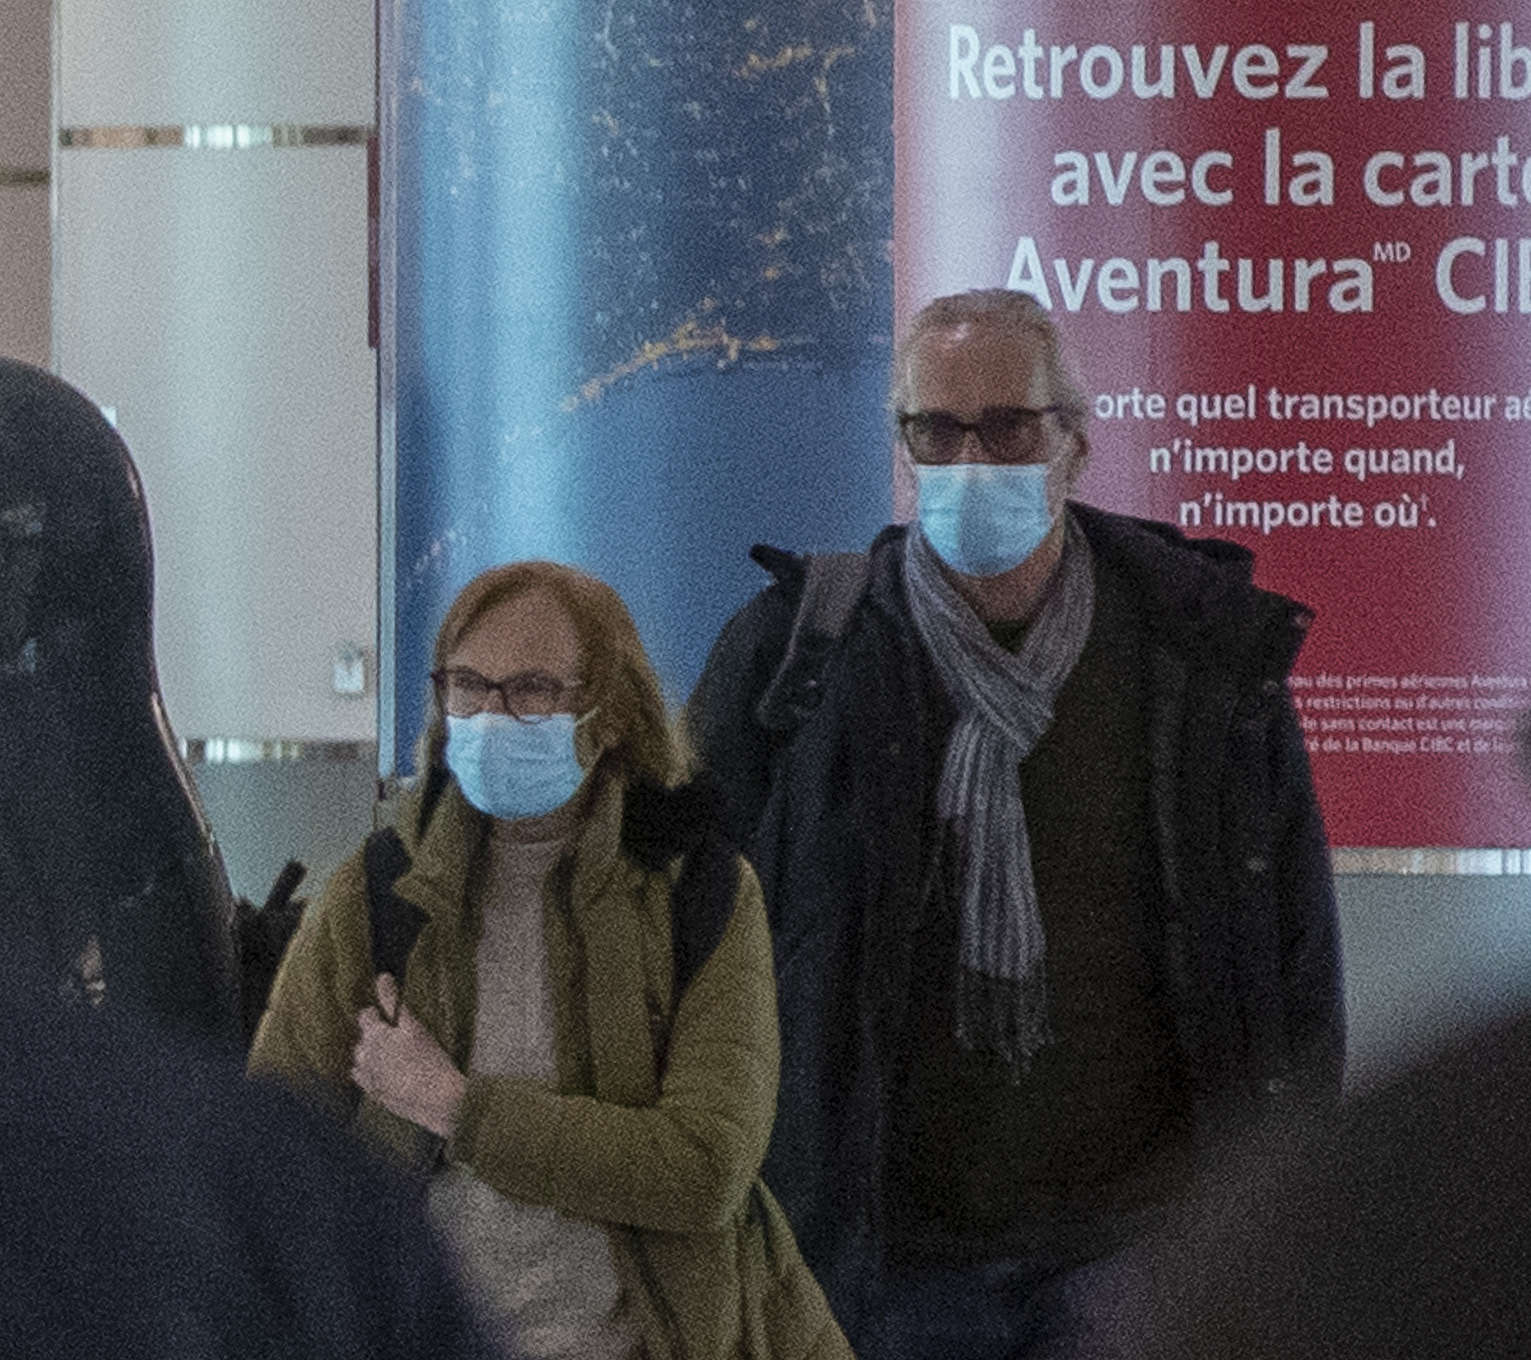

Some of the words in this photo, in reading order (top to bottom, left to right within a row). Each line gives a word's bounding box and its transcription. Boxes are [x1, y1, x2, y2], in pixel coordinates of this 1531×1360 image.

[949, 23, 1329, 99] Retrouvez
[1359, 20, 1425, 100] la
[1051, 150, 1233, 207] avec
[1265, 129, 1334, 207] la
[1364, 135, 1531, 207] cart
[1176, 384, 1256, 426] quel
[1268, 385, 1497, 428] transporteur
[1150, 438, 1333, 481] n'importe
[1344, 439, 1466, 480] quand,
[1179, 492, 1364, 535] n'importe
